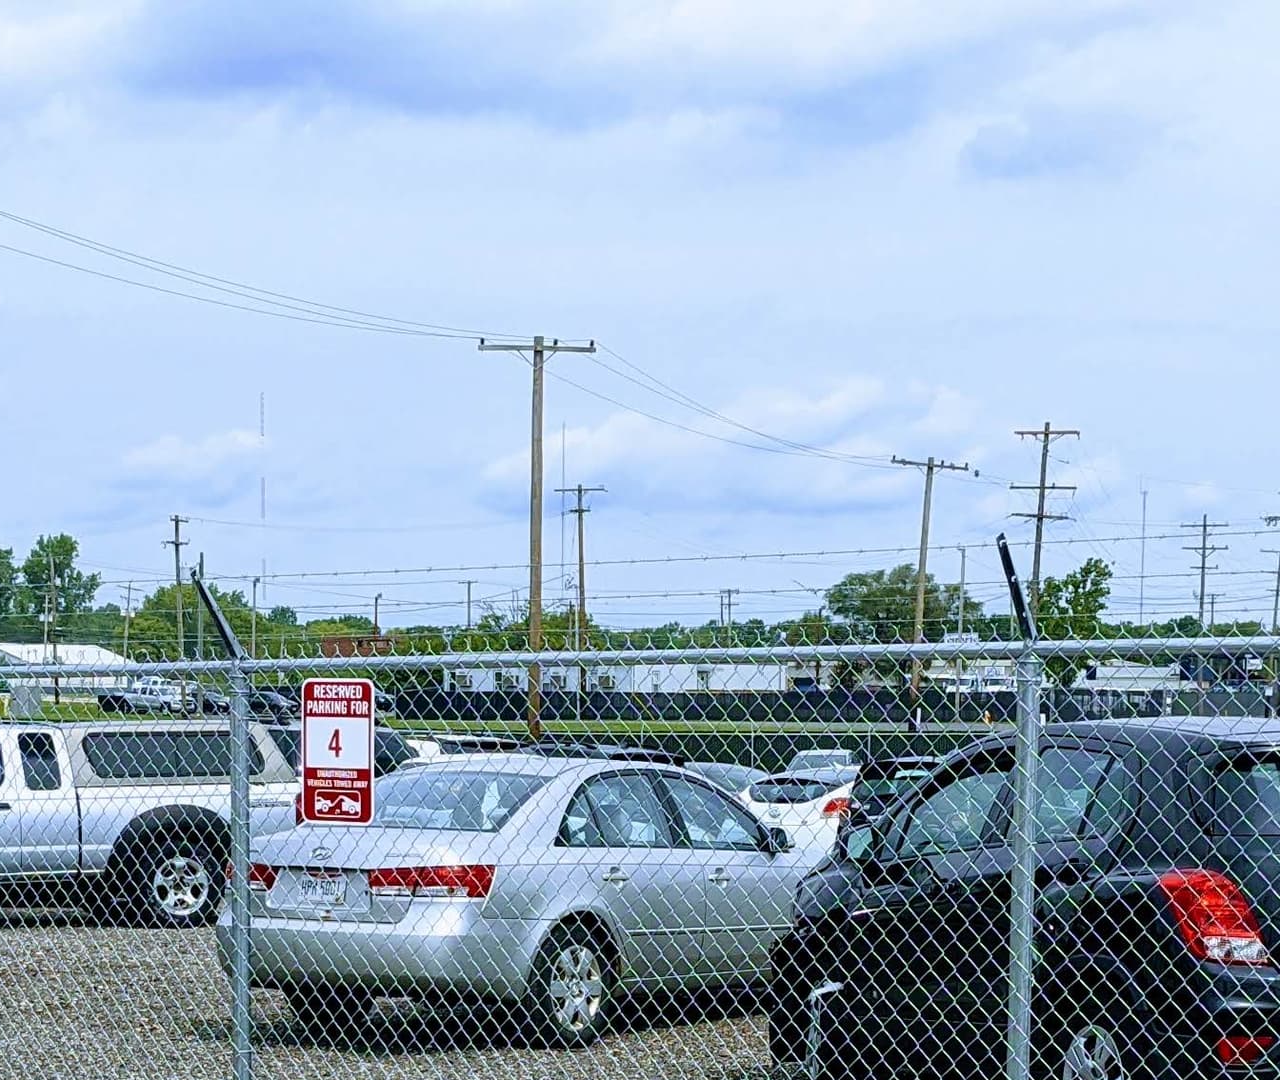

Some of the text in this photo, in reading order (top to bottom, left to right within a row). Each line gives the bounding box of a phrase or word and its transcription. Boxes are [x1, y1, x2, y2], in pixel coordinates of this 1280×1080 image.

[313, 684, 363, 699] RESERVED
[306, 700, 369, 715] PARKING FOR
[328, 729, 342, 758] 4
